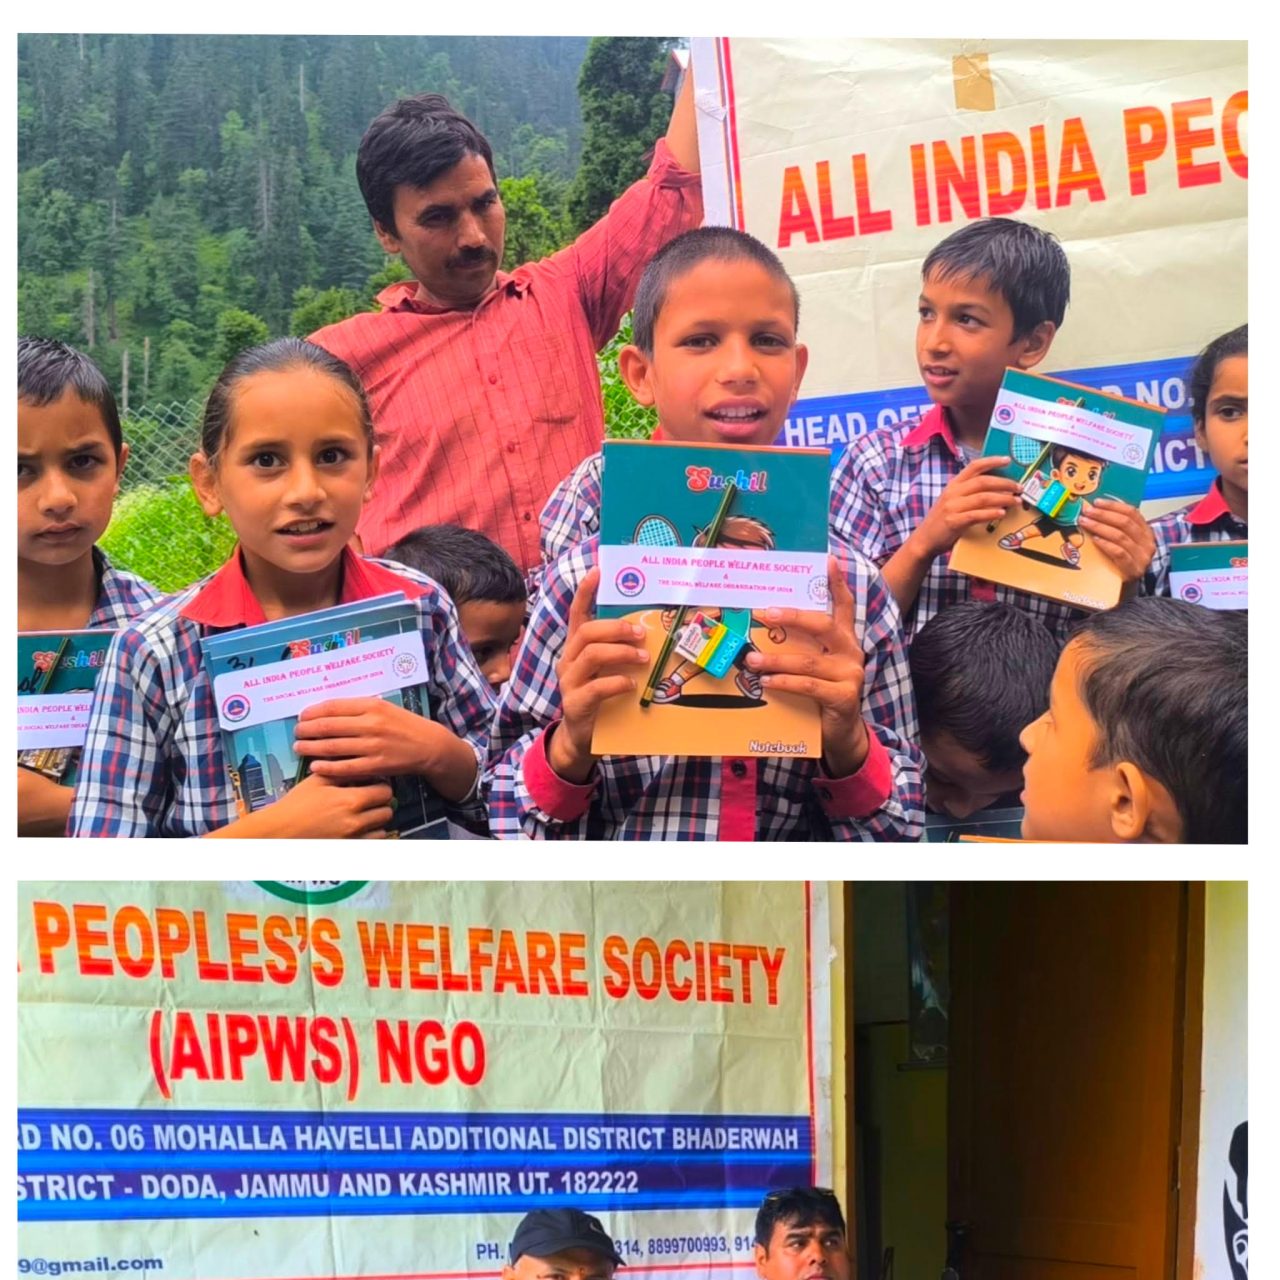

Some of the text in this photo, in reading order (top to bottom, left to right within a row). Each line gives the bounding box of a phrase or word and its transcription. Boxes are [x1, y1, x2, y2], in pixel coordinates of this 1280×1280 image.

[777, 153, 892, 248] ALL
[910, 117, 1106, 226] INDIA
[785, 411, 868, 447] HEAD
[1135, 378, 1195, 409] NO.
[685, 465, 767, 493] Sushil
[641, 555, 813, 575] ALL INDIA PEOPLE WELFARE SOCIETY
[243, 646, 395, 689] ALL INDIA PEOPLE WELFARE SOCIETY
[42, 704, 72, 713] PEOPLE
[749, 740, 807, 754] Notebook
[33, 901, 788, 1006] PEOPLES'S WELFARE SOCIETY
[149, 1010, 487, 1101] (AIPWS) NGO
[51, 1125, 798, 1151] NO. 06 MOHALLA HAVELLI ADDITIONAL DISTRICT BHADERWAH
[141, 1174, 226, 1203] DODA,
[235, 1174, 330, 1199] JAMMU
[338, 1173, 392, 1198] AND
[400, 1172, 512, 1196] KASHMIR
[519, 1172, 554, 1195] UT.
[561, 1171, 638, 1194] 182222
[648, 1235, 730, 1255] 8899700993,
